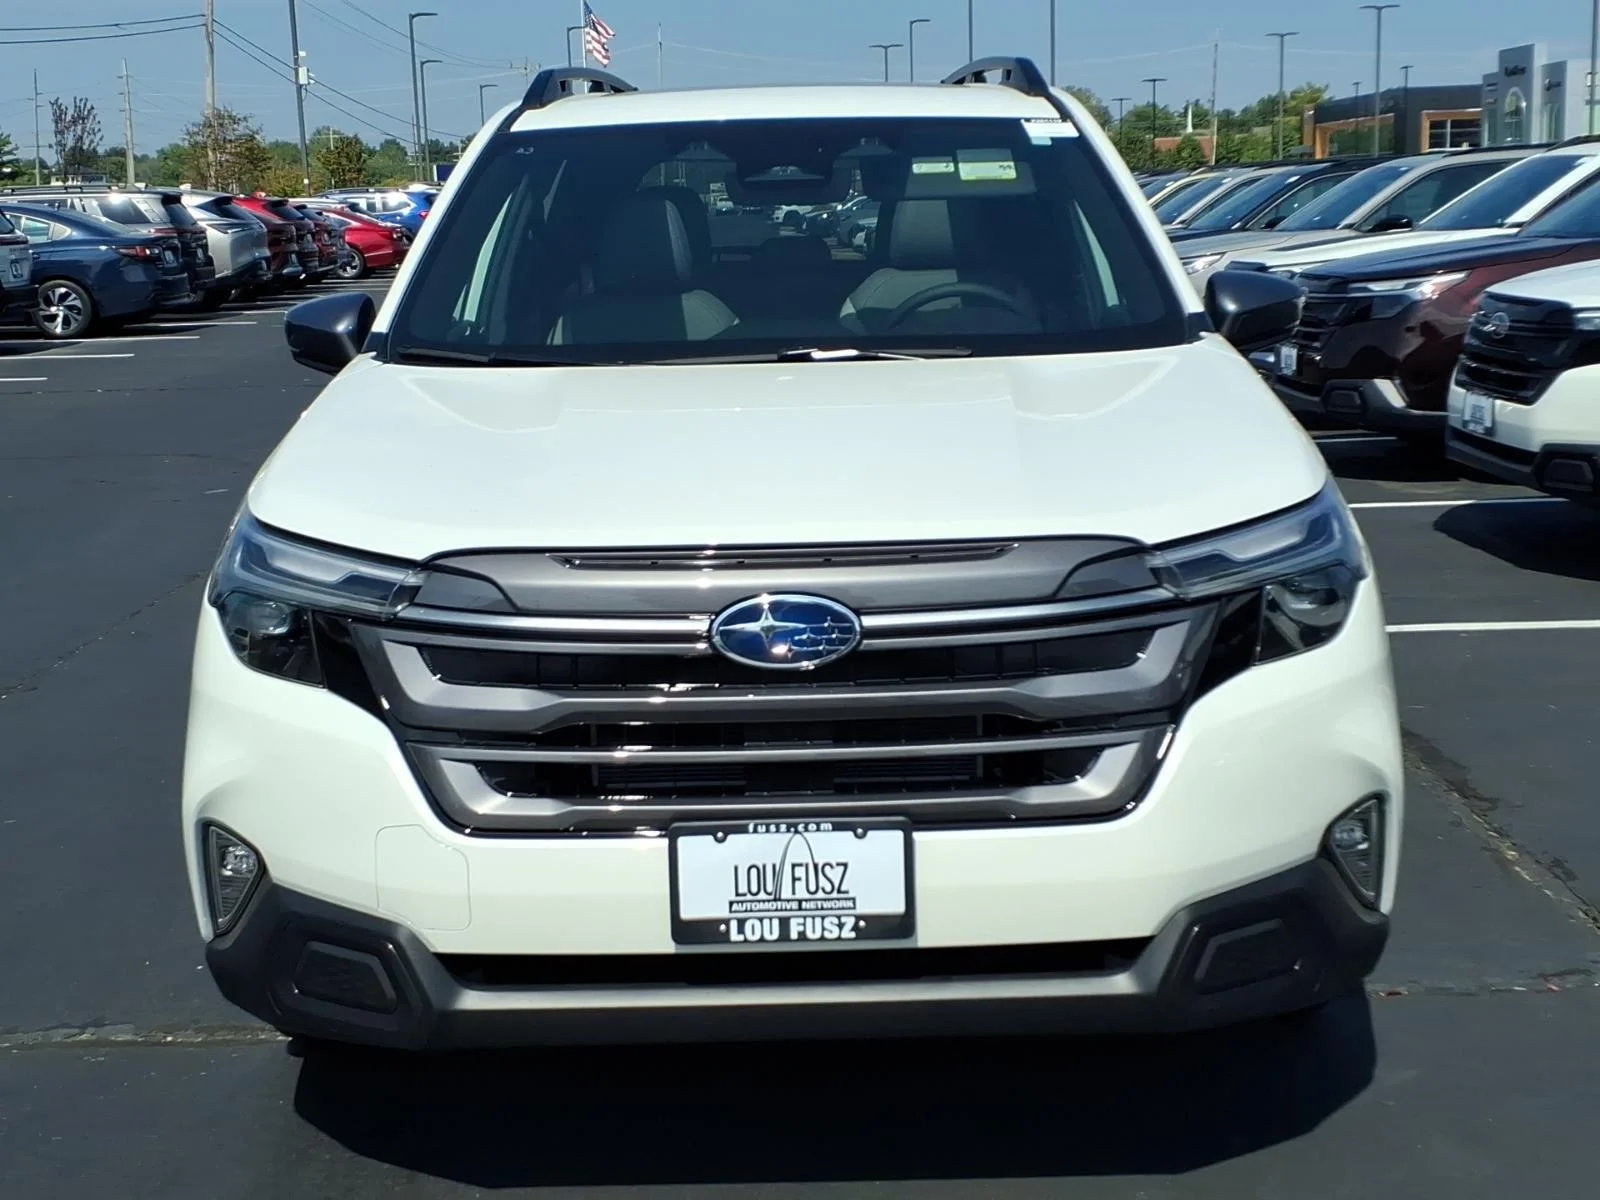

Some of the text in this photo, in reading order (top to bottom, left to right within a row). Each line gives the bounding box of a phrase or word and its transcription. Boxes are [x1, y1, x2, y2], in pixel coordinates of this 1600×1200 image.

[748, 822, 833, 834] fusz.com
[734, 862, 849, 898] LOU FUSZ
[731, 899, 855, 912] AUTOMOTIVE NETWORK
[729, 915, 857, 942] LOU FUSZ
